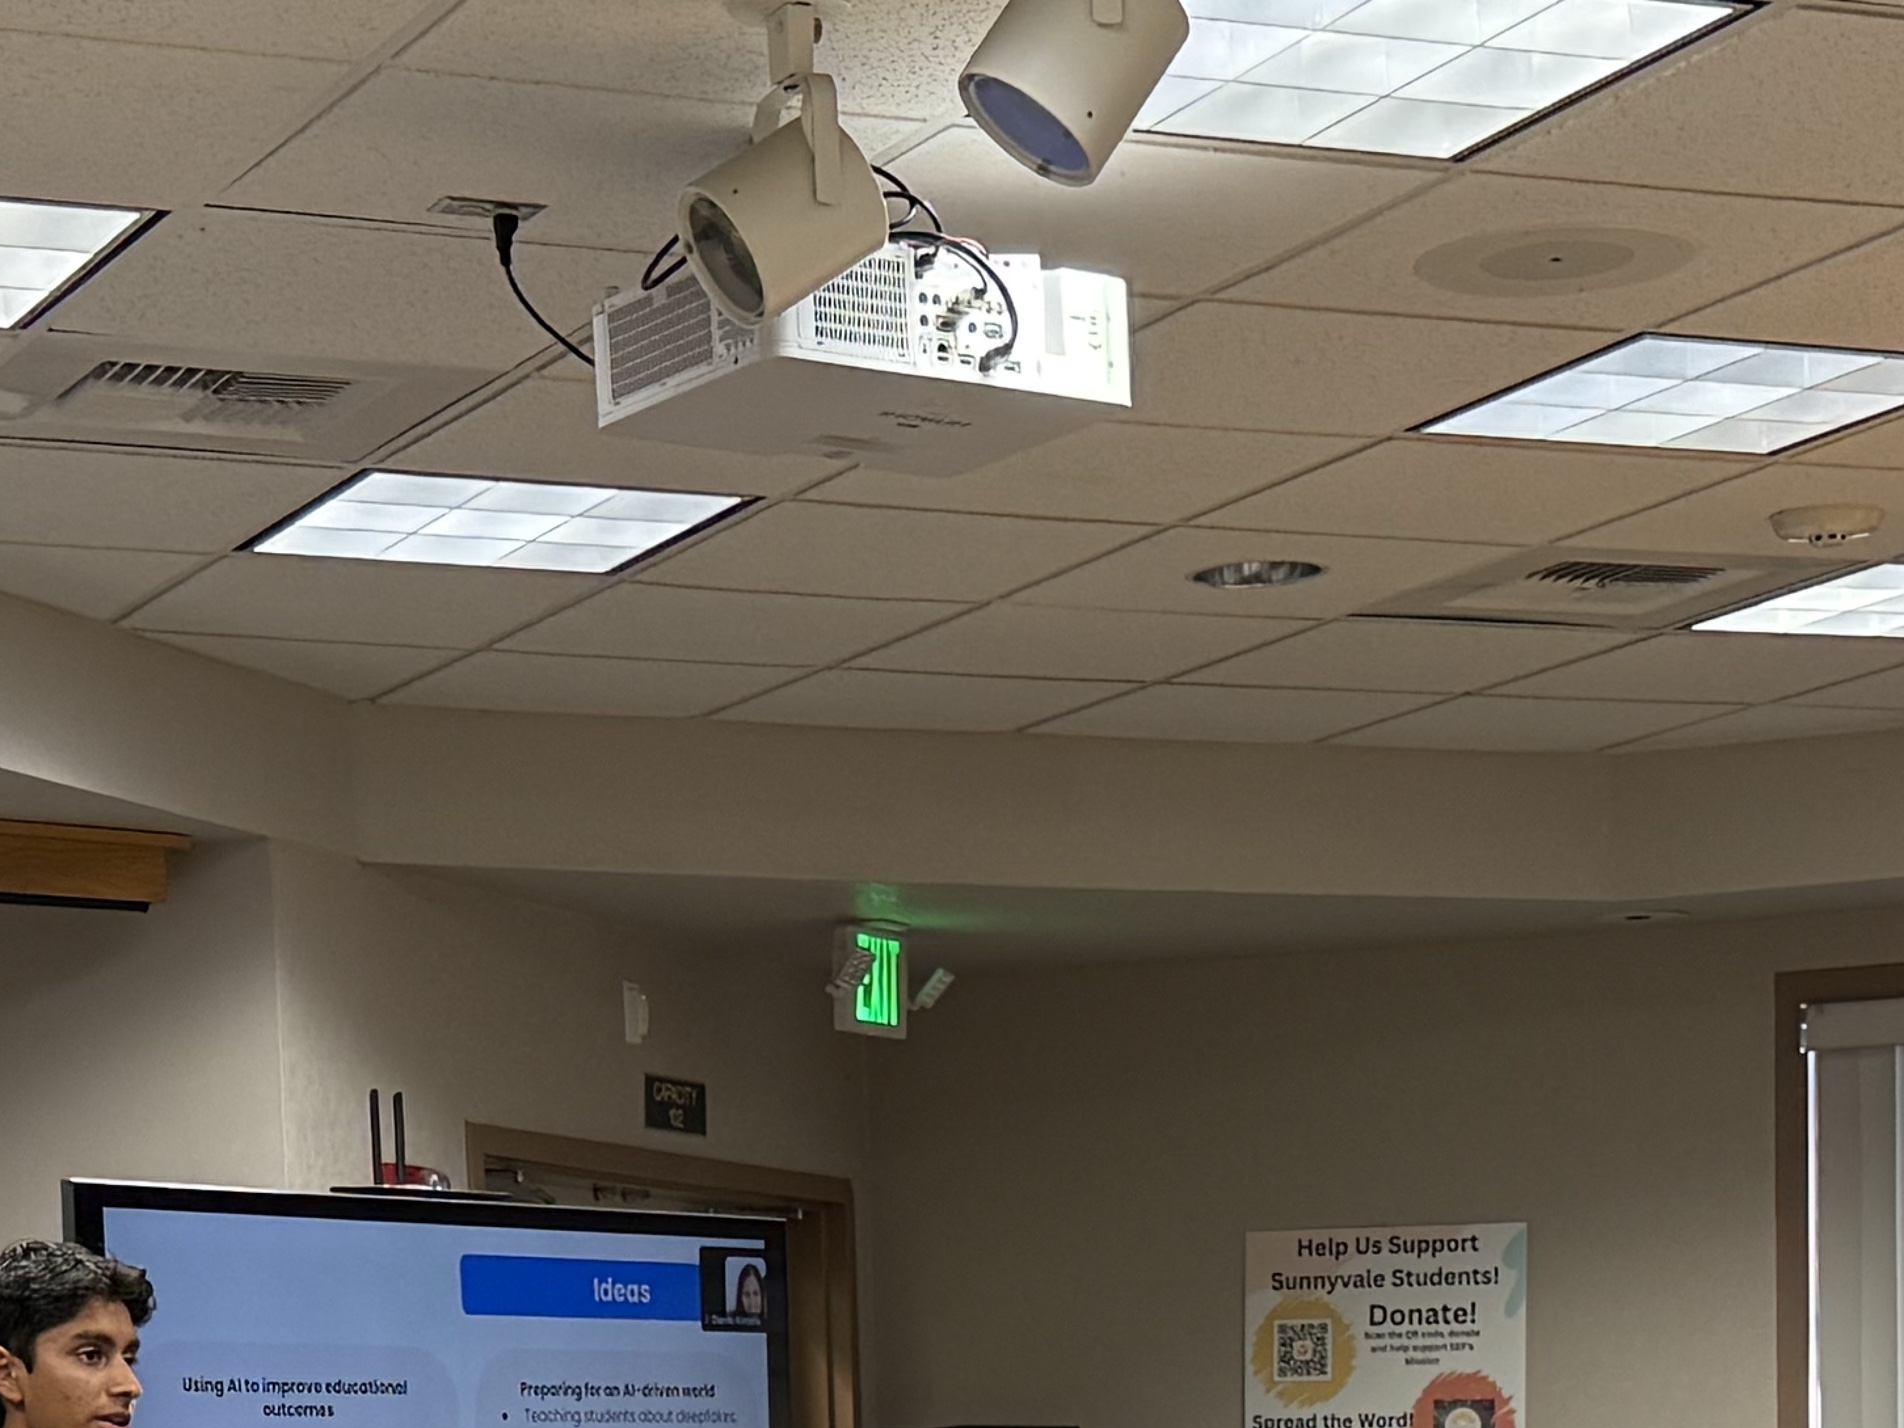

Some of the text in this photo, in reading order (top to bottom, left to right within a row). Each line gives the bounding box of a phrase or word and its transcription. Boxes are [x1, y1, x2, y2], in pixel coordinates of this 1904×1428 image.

[1297, 1234, 1480, 1261] Help Us Support
[593, 1276, 651, 1304] Ideas
[1271, 1267, 1499, 1294] Sunnyvale Students!
[1369, 1302, 1477, 1327] Donate!
[182, 1377, 224, 1397] Using
[246, 1378, 260, 1393] to
[262, 1378, 322, 1398] improve
[325, 1379, 408, 1395] educational
[520, 1382, 582, 1401] Preparing
[604, 1386, 620, 1397] an
[263, 1402, 334, 1418] outcomes
[525, 1408, 582, 1428] Teaching
[584, 1409, 636, 1423] students
[638, 1409, 673, 1424] about
[1323, 1413, 1353, 1428] the
[1358, 1412, 1414, 1428] Word!
